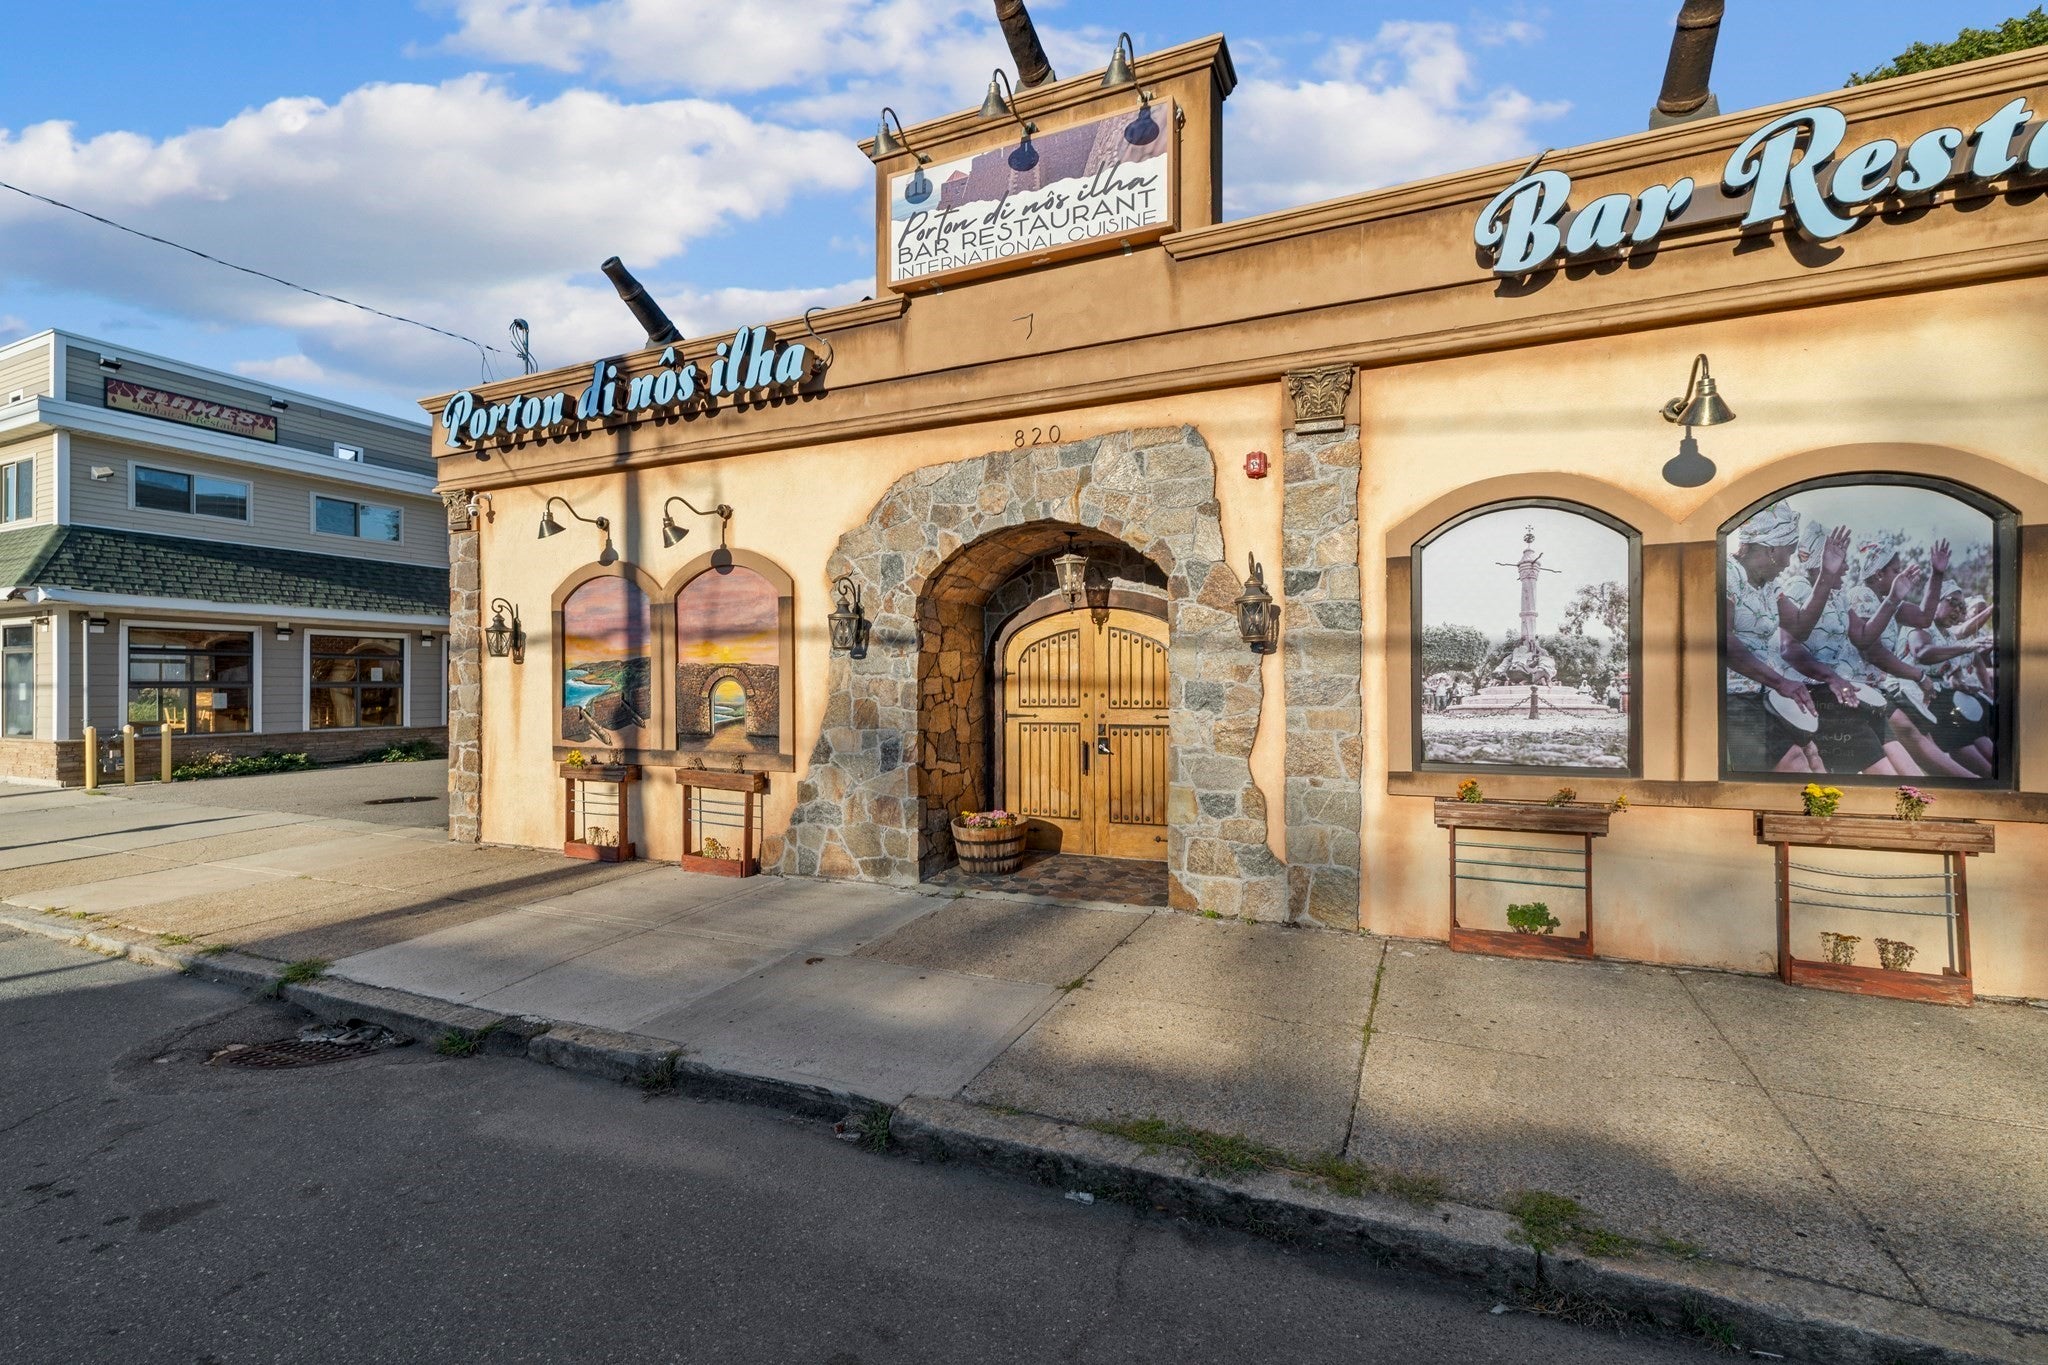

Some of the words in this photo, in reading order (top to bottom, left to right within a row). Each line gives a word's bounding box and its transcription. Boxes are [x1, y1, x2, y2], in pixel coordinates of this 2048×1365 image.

[898, 205, 978, 249] Porton
[984, 190, 1016, 223] di
[1022, 192, 1069, 215] nôs
[1078, 160, 1158, 199] ilha
[1474, 169, 1694, 273] Bar
[1722, 96, 2048, 241] Rest
[898, 233, 1062, 280] INTERNATIONAL
[1068, 209, 1157, 240] CUISINE
[899, 238, 949, 265] BAR
[962, 188, 1156, 248] RESTAURANT
[133, 402, 192, 420] Jamaican
[196, 416, 255, 435] Restaurant
[136, 387, 256, 424] FLAMES
[442, 390, 565, 448] Porton
[577, 360, 618, 420] di
[627, 346, 697, 411] nôs
[710, 325, 806, 397] ilha
[1014, 425, 1061, 448] 820
